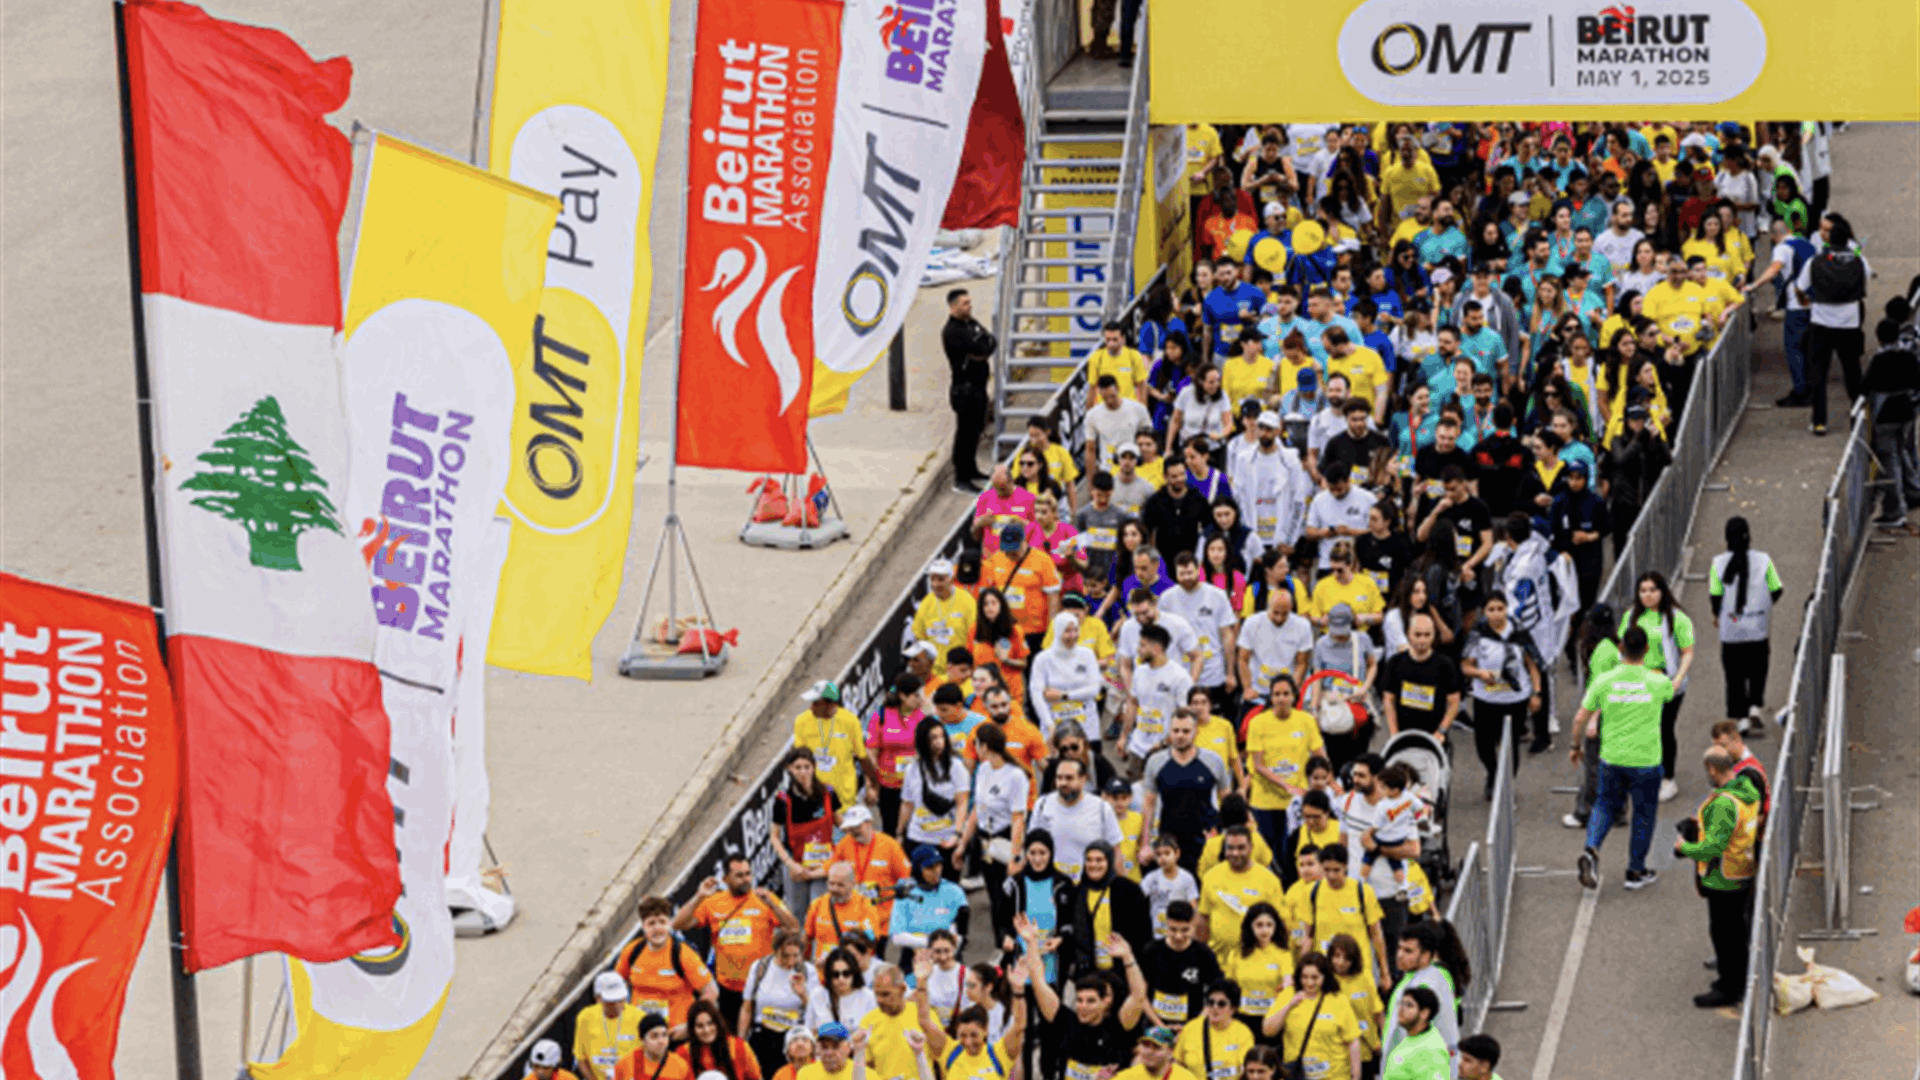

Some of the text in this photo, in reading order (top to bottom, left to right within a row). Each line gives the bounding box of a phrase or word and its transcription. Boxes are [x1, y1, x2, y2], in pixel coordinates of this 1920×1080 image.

[703, 38, 757, 225] Beirut
[752, 44, 790, 227] MARATHON
[925, 0, 957, 93] MARA
[1371, 23, 1532, 76] OMT
[1577, 48, 1710, 64] MARATHON
[1577, 69, 1710, 89] MAY 1, 2025
[783, 48, 819, 232] Association
[524, 144, 618, 500] OMT Pay
[841, 131, 921, 337] OMT
[417, 410, 475, 641] MARATHON
[29, 627, 104, 900] MARATHON
[77, 638, 148, 906] Association
